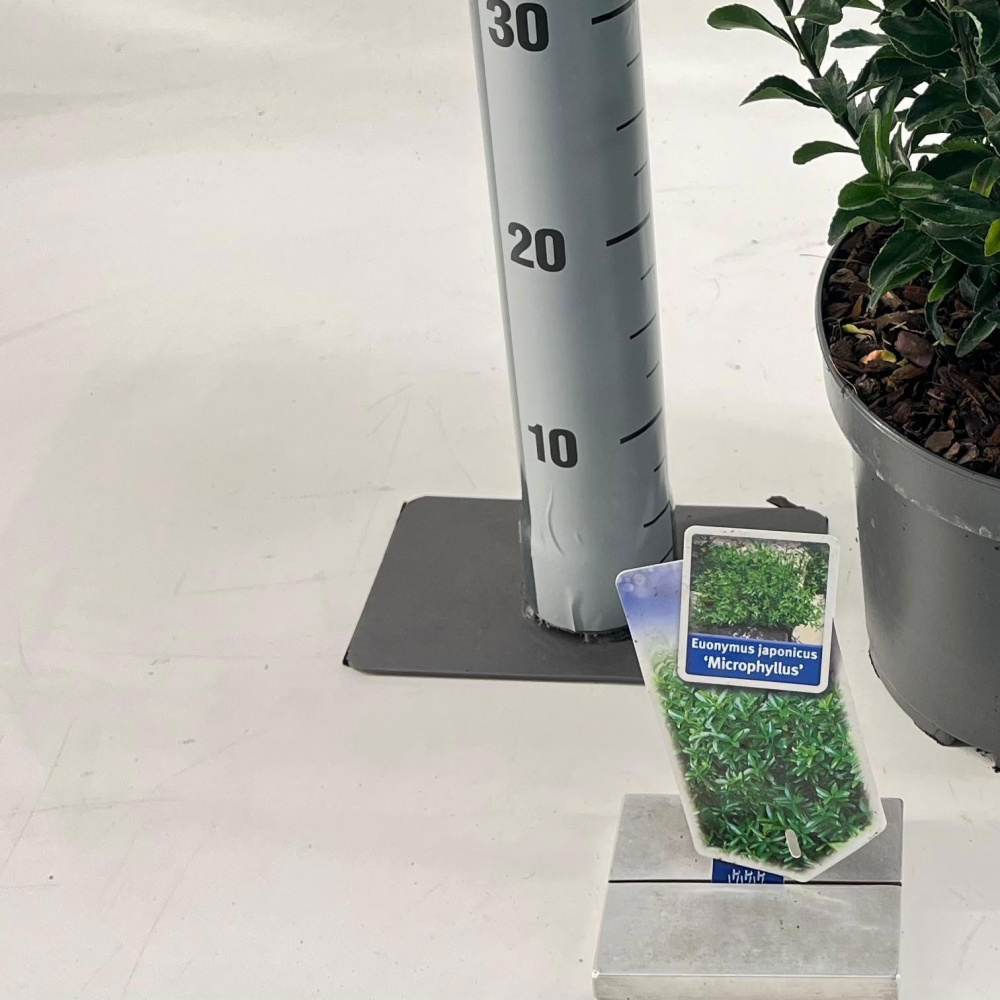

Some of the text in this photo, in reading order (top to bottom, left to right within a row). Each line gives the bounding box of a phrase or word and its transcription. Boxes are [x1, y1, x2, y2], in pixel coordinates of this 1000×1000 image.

[507, 222, 567, 273] 20
[527, 423, 578, 469] 10
[691, 637, 818, 660] Euonymus japonicus
